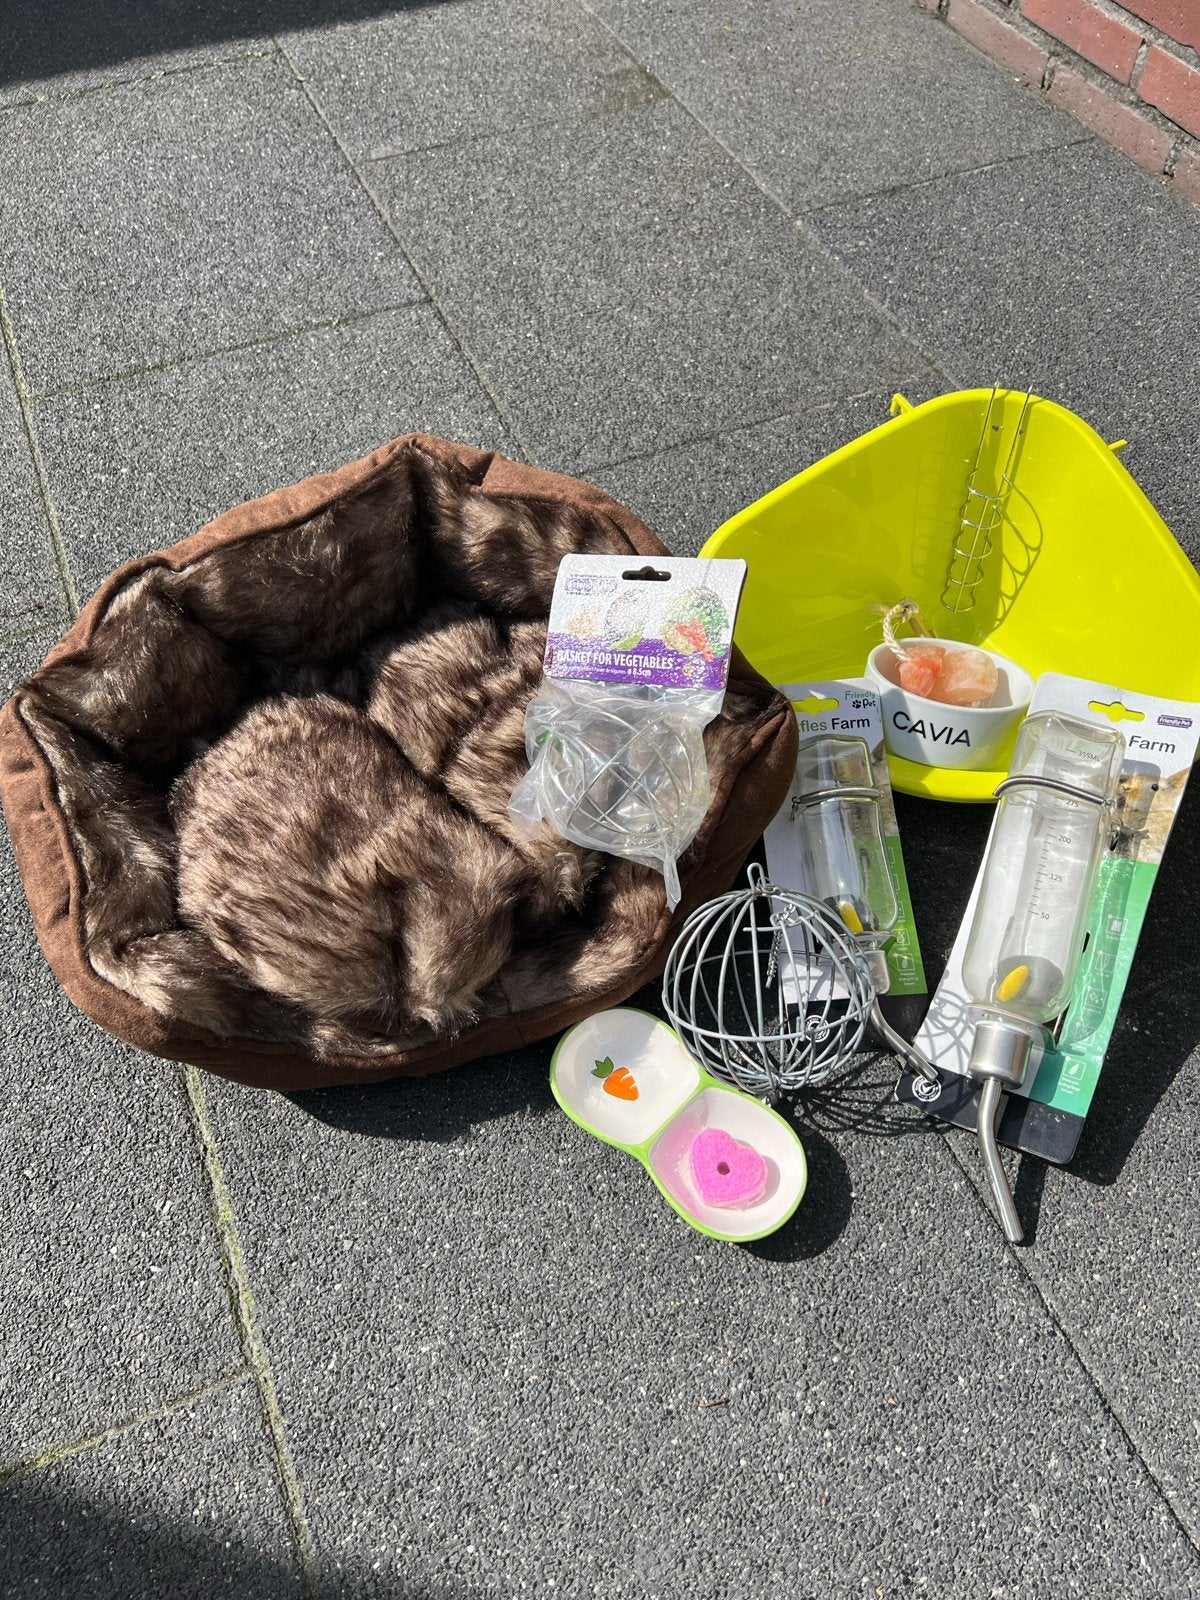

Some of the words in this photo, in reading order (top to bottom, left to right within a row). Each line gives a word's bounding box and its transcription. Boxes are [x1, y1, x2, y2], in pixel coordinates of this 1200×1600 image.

[556, 649, 591, 663] BASKET
[592, 652, 612, 665] FOR
[613, 653, 674, 670] VEGETABLES
[844, 690, 876, 700] Friendly
[862, 698, 876, 709] Pet
[799, 719, 828, 732] fles
[831, 717, 871, 730] Farm
[1159, 717, 1180, 725] Friendly
[892, 711, 971, 747] CAVIA
[1128, 735, 1176, 754] Farm
[1066, 799, 1080, 809] 275
[1058, 834, 1072, 845] 200
[1050, 873, 1063, 883] 125
[1040, 912, 1050, 920] 50
